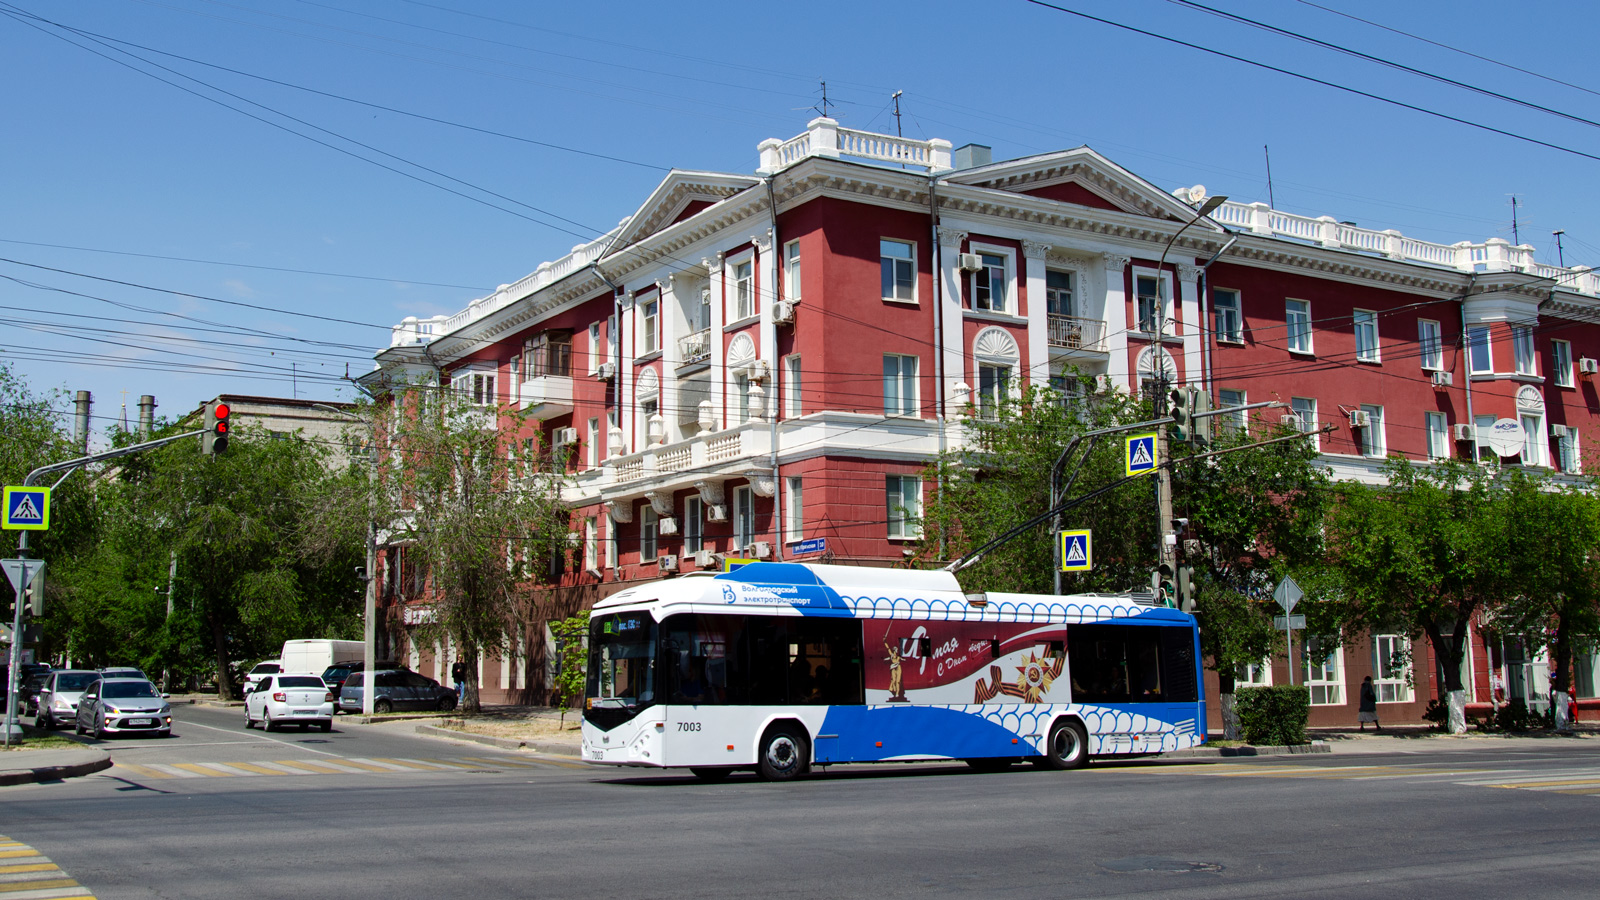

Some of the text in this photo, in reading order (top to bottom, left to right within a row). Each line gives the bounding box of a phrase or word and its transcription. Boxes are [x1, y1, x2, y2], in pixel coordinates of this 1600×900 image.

[741, 585, 799, 595] Волгоградский
[743, 596, 812, 606] электротранспорт
[931, 637, 960, 660] мая
[937, 662, 945, 677] С
[676, 722, 702, 732] 7003
[591, 750, 604, 760] 7003
